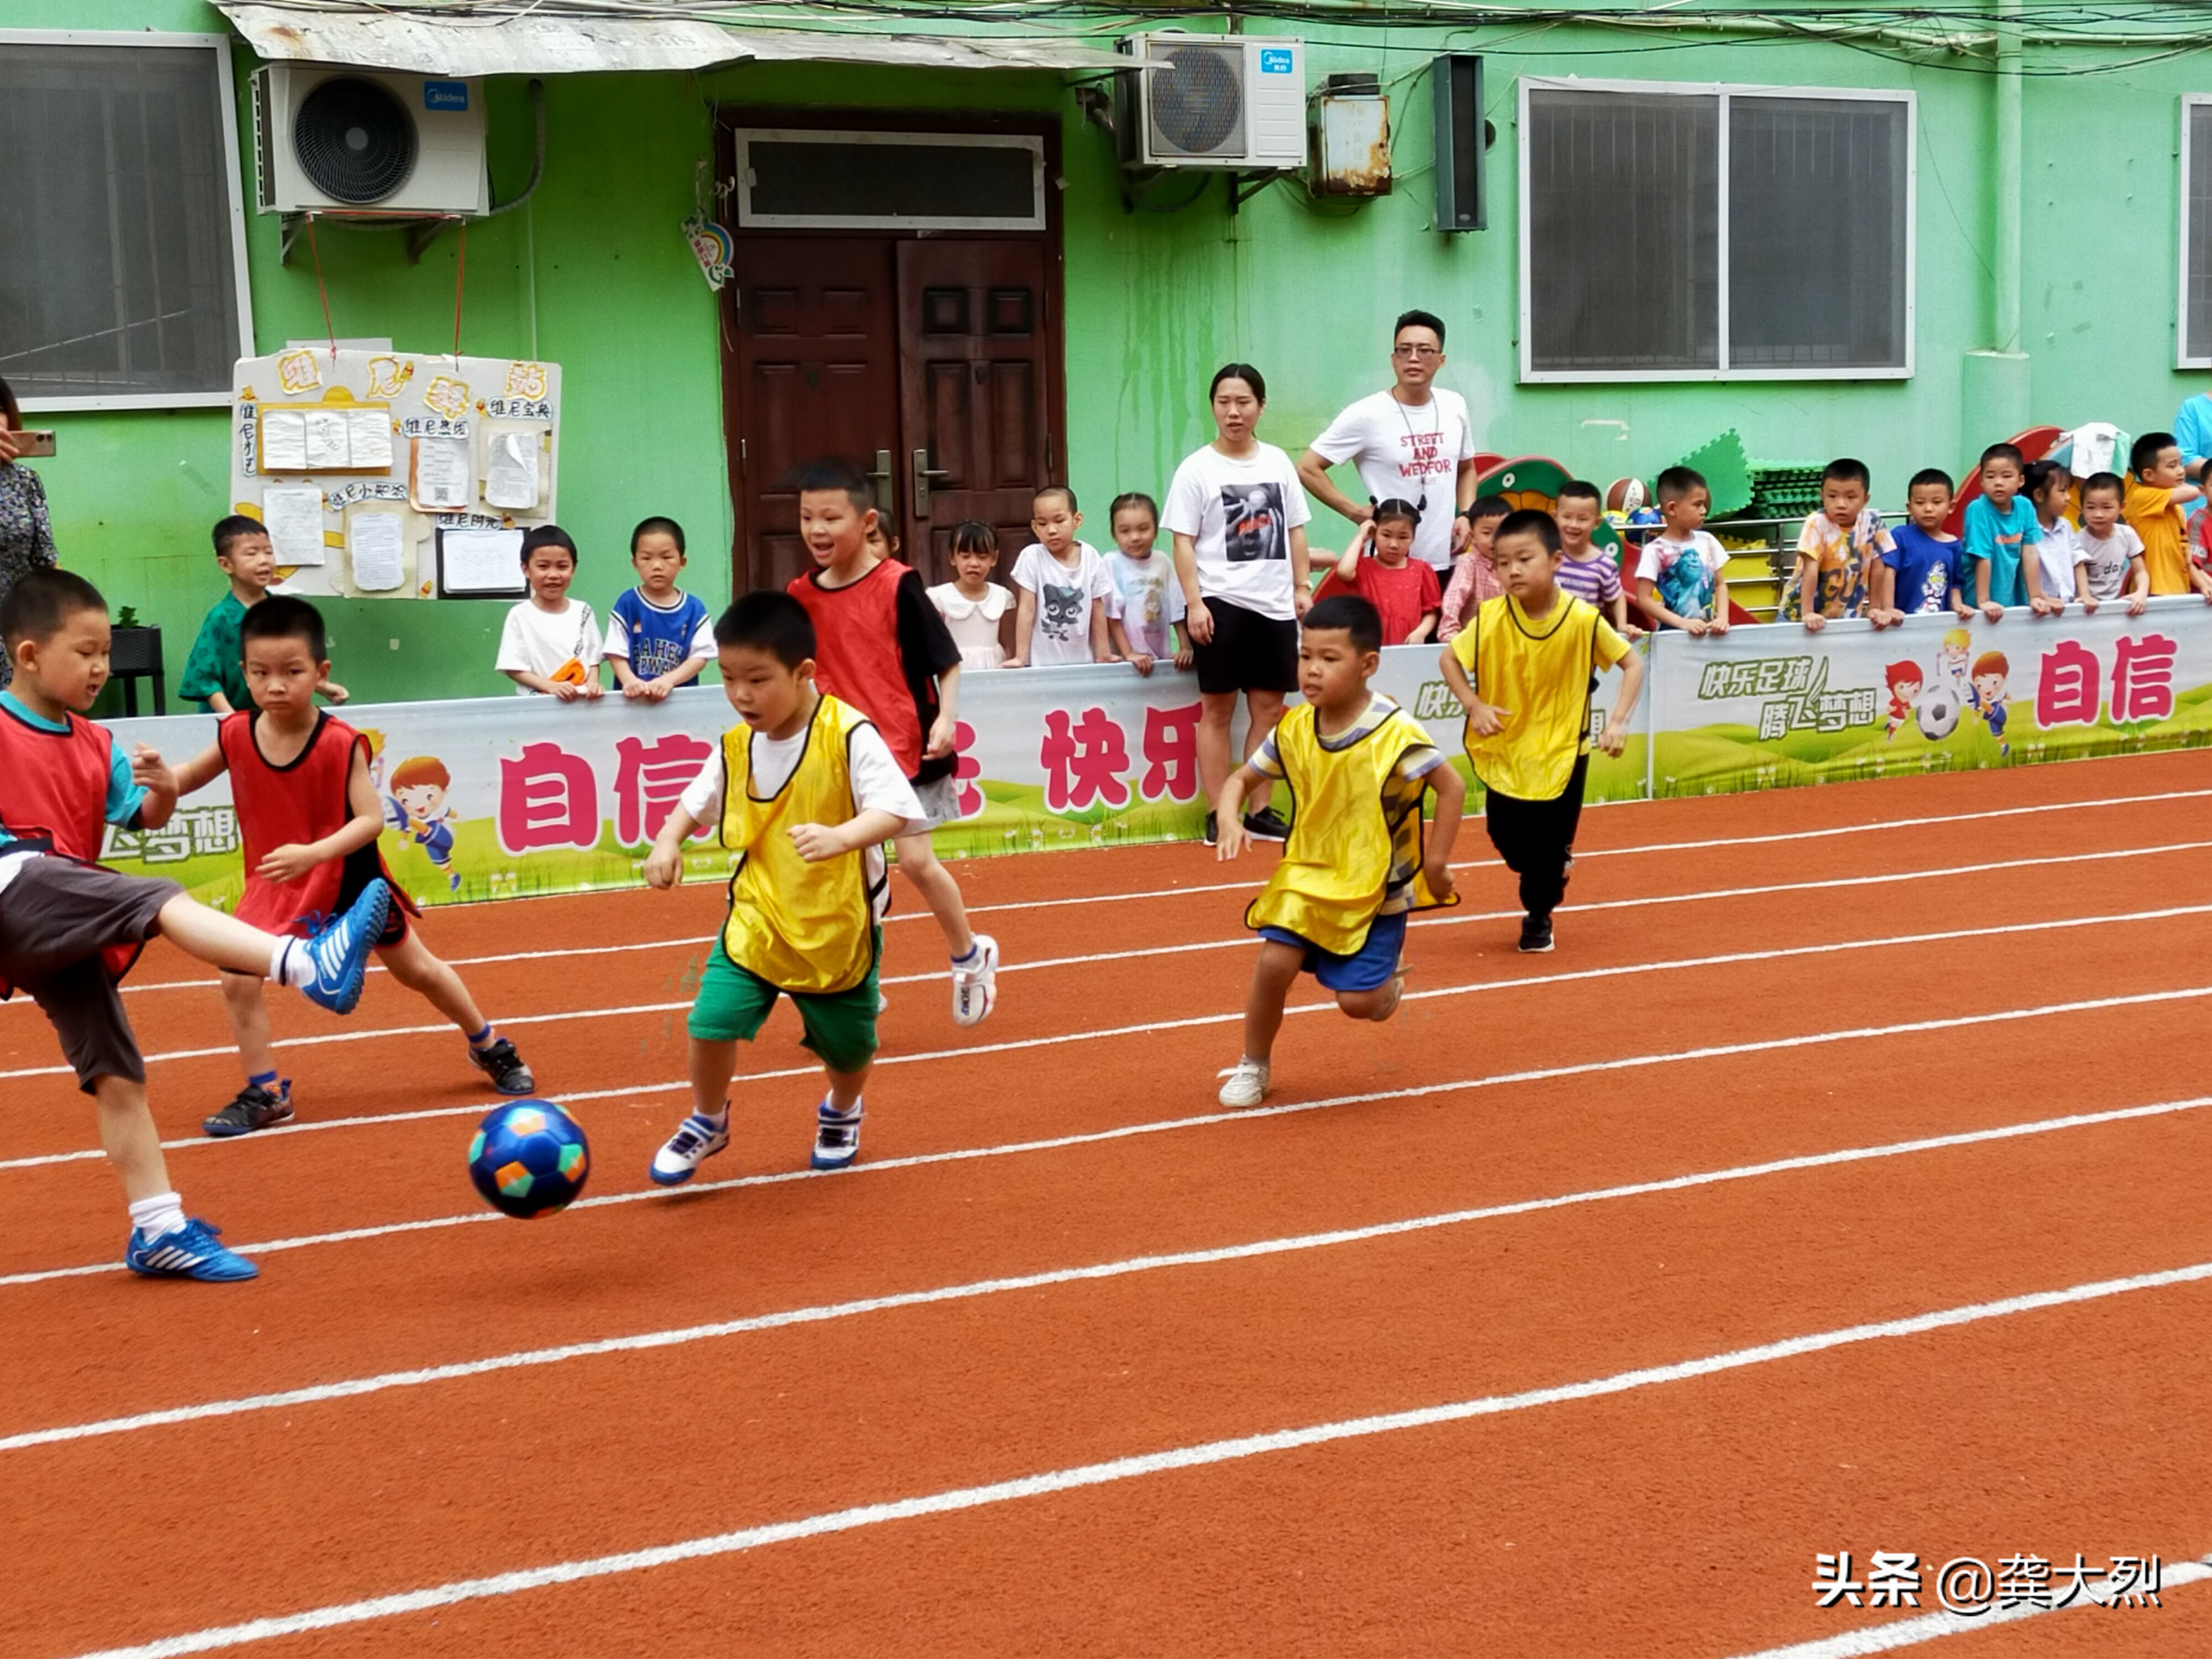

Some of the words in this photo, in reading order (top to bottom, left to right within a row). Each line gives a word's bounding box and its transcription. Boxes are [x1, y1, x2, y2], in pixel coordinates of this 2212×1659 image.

[434, 92, 465, 103] Midea
[1413, 446, 1438, 460] AND
[1699, 656, 1813, 699] 快乐足球
[2037, 634, 2177, 727] 自信
[1760, 688, 1876, 741] 腾飞梦想
[1040, 701, 1202, 810] 快乐
[500, 733, 714, 852] 自信
